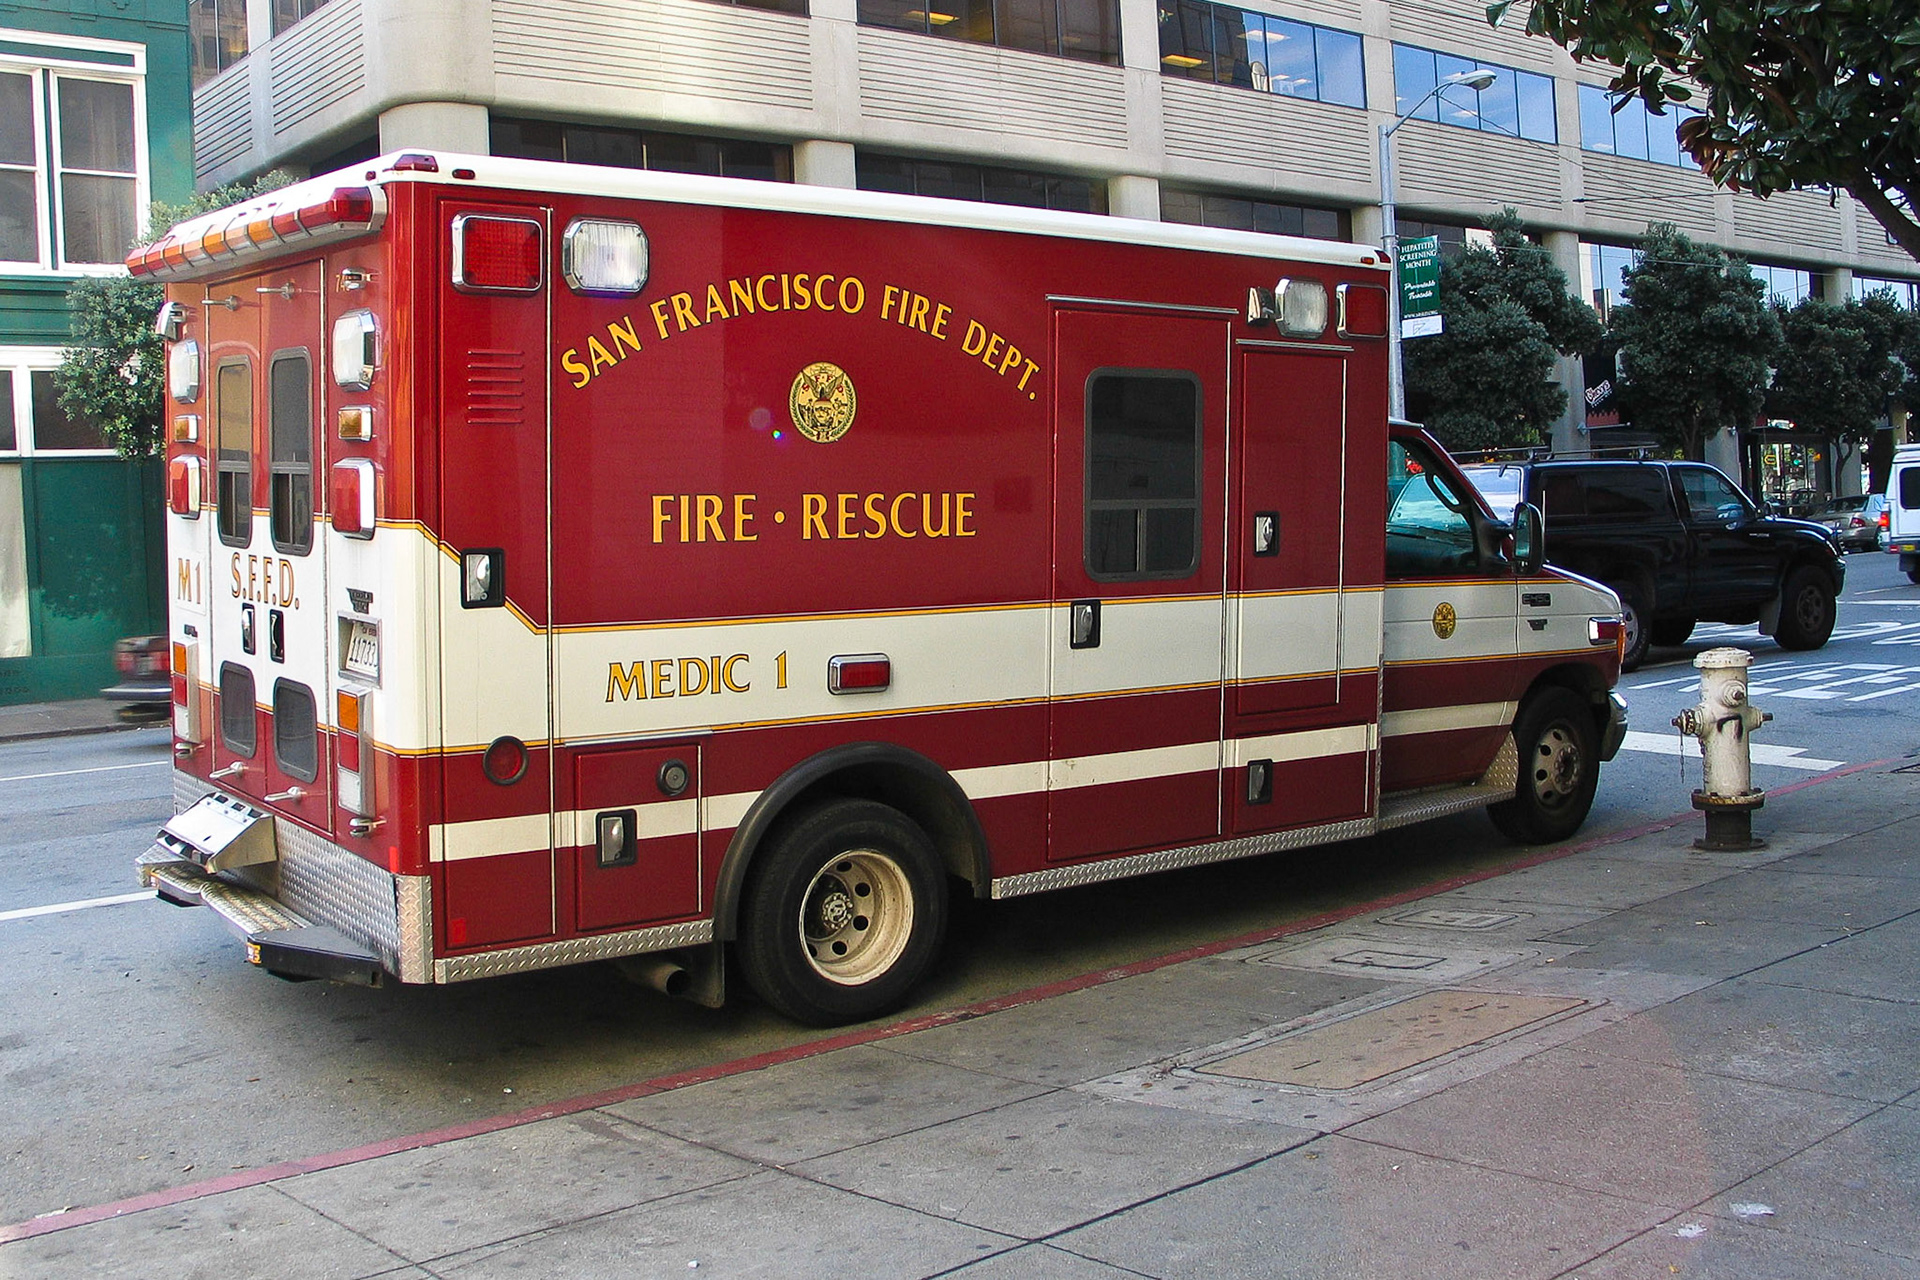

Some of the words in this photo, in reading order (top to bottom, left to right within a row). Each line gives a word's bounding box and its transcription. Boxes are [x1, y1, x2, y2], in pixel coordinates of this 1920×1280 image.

[1399, 251, 1437, 262] SCREENING
[1401, 242, 1434, 253] HEPATITIS
[1405, 259, 1432, 269] MONTH
[560, 315, 642, 390] SAN
[649, 273, 866, 341] FRANCISCO
[879, 283, 953, 342] FIRE
[960, 318, 1042, 402] DEPT.
[651, 493, 759, 544] FIRE
[801, 491, 977, 541] RESCUE
[231, 551, 300, 610] S.F.F.D.
[605, 653, 751, 702] MEDIC
[774, 650, 788, 689] 1
